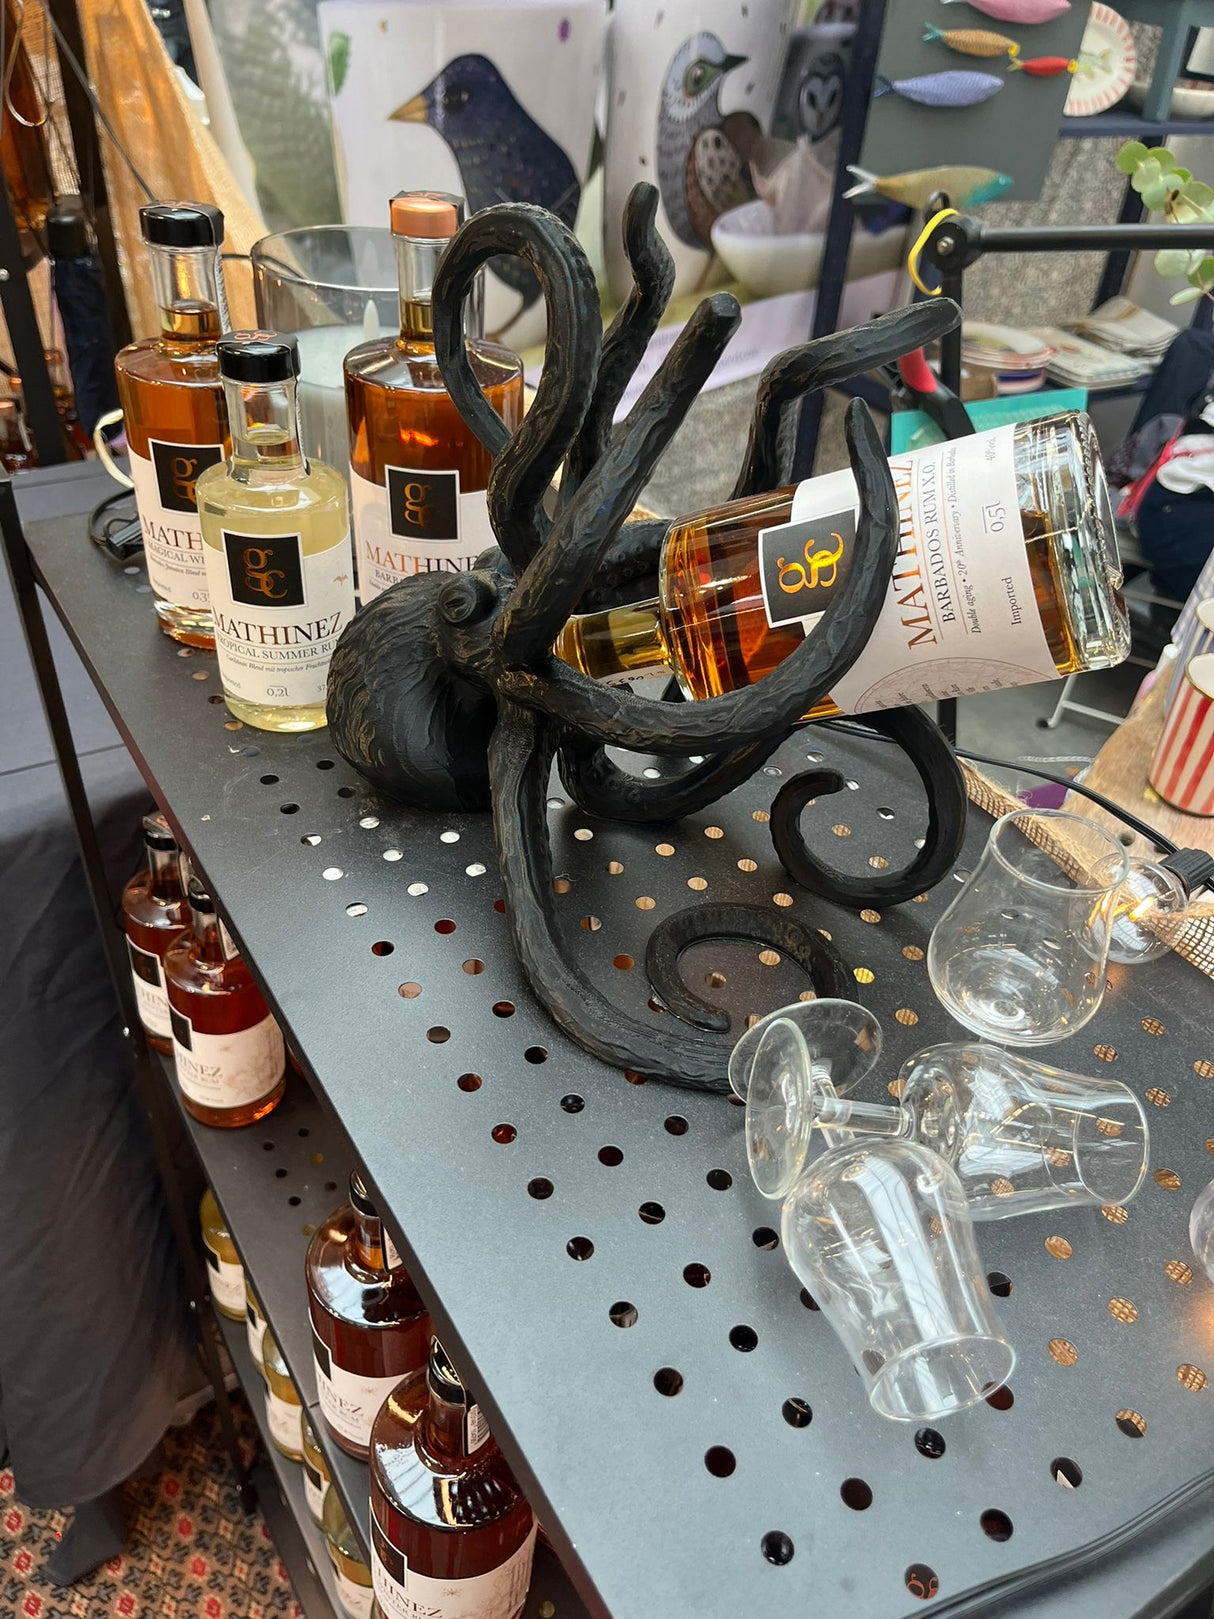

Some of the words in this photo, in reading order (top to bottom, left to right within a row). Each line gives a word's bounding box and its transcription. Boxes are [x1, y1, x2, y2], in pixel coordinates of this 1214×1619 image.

[923, 489, 939, 525] RUM
[985, 500, 1007, 533] 0,5l
[950, 510, 965, 557] Anniversary
[925, 528, 957, 624] BARBADOS
[962, 584, 975, 607] aging
[1001, 576, 1022, 626] Imported
[212, 606, 343, 646] MATHINEZ
[966, 605, 982, 634] Double
[262, 646, 318, 660] SUMMER
